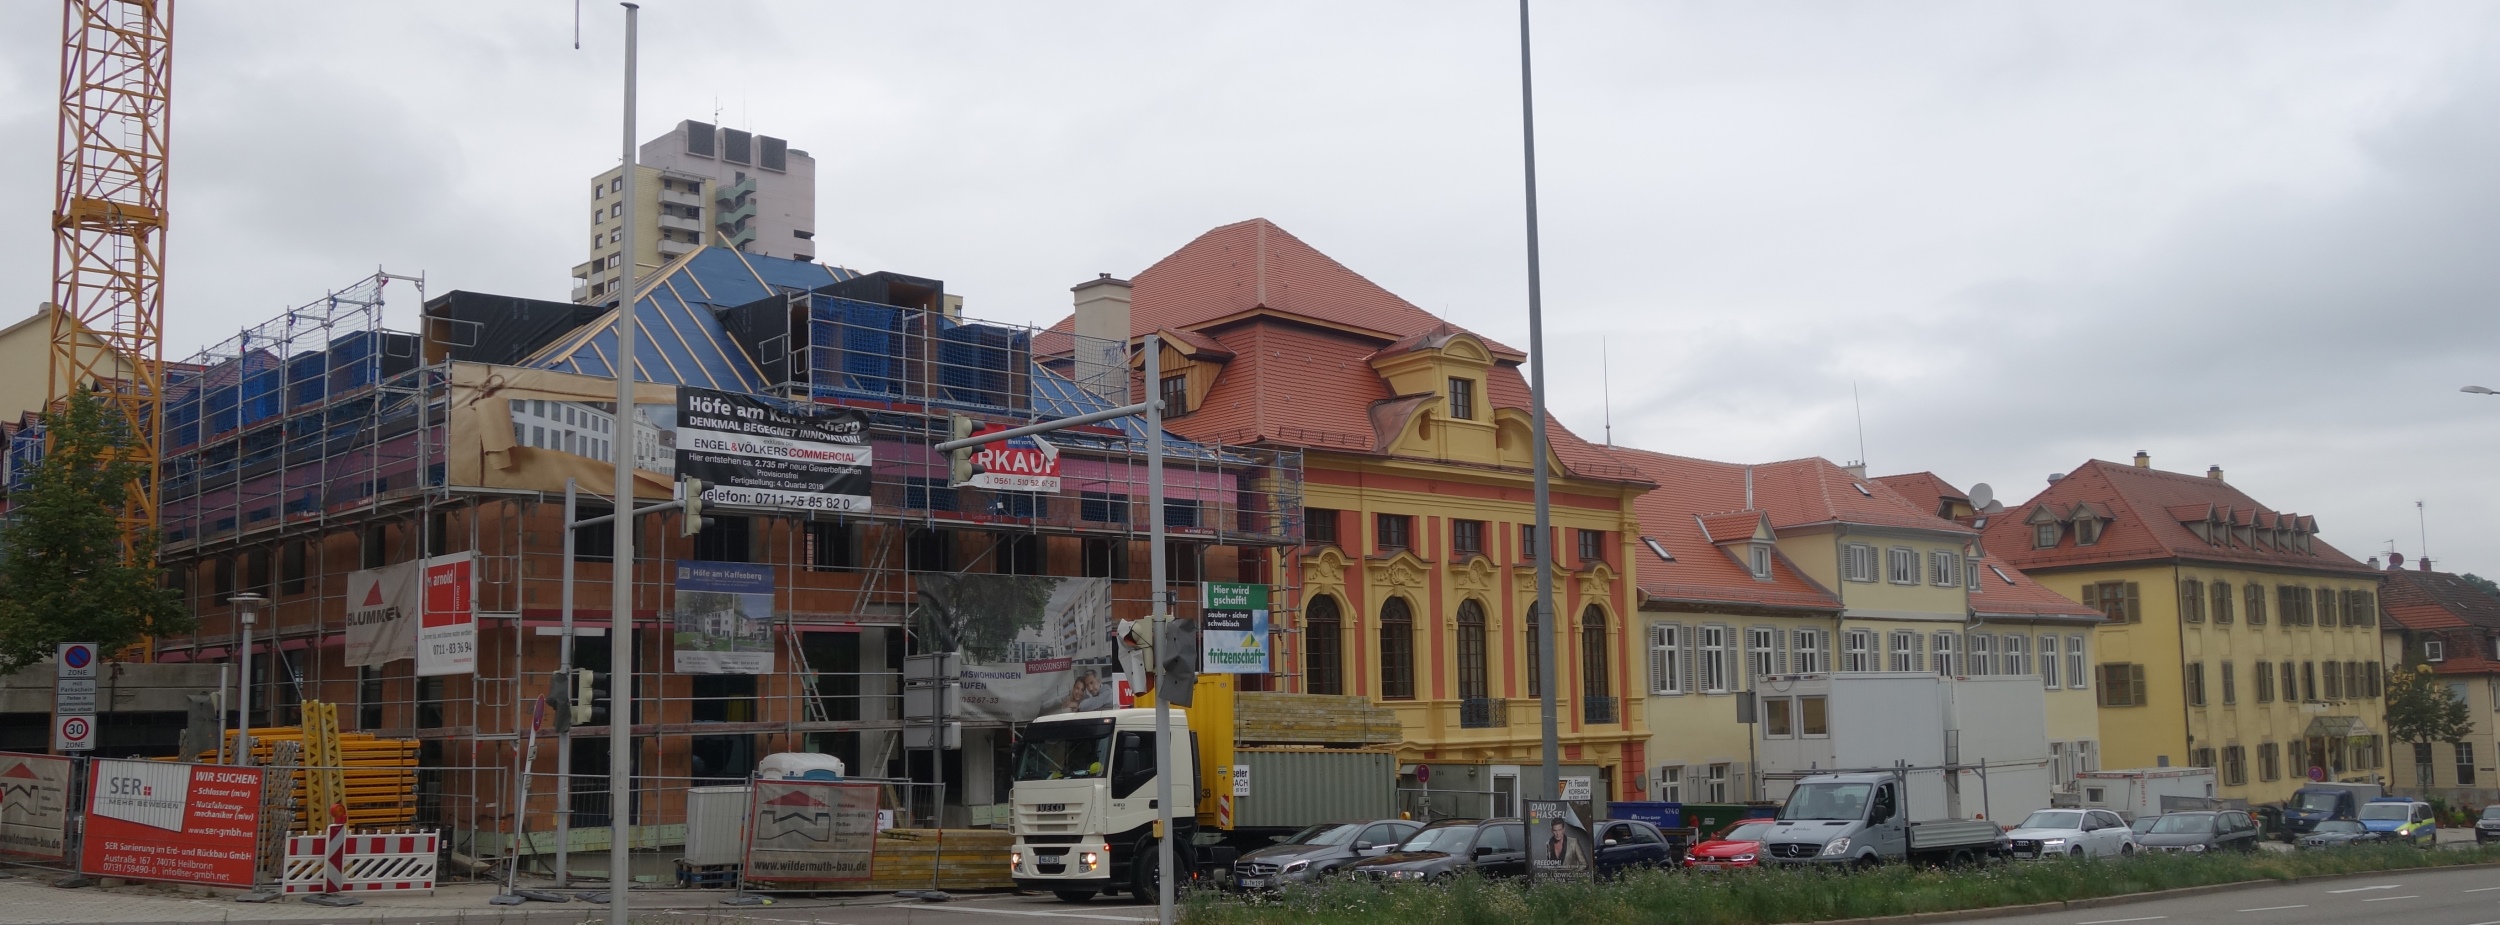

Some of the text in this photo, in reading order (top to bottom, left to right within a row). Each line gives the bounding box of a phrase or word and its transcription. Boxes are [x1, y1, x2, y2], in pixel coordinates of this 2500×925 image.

[689, 396, 731, 416] Höfe
[737, 406, 764, 421] am
[689, 416, 861, 445] DENKMAL BEGEGNET INNOVATION!
[789, 448, 857, 463] COMMERCIAL
[688, 453, 862, 476] Hier entstehen ca. 2.735 m² neue Gewerbeflächen
[757, 469, 799, 480] Provisionsfrei
[730, 475, 776, 488] Fertigstellung:
[784, 480, 807, 490] Quartal
[808, 482, 824, 490] 2019
[993, 477, 1012, 486] 0561
[1016, 478, 1029, 486] 510
[755, 492, 804, 507] 0711-75
[808, 495, 822, 508] 85
[826, 496, 840, 509] 82
[843, 498, 851, 510] 0
[433, 569, 454, 586] arnold
[693, 569, 710, 577] Höfe
[712, 570, 723, 578] am
[724, 571, 762, 581] Kaffeeberg
[1213, 585, 1250, 595] Hier wird
[1213, 595, 1247, 606] gschafft!
[433, 641, 472, 656] 0711 83 36 94
[1208, 648, 1265, 665] fritzenschaft
[68, 723, 84, 735] 30
[195, 771, 258, 785] WIR SUCHEN:
[110, 776, 142, 797] SER
[198, 787, 251, 799] Schlosser (m/w)
[137, 800, 179, 810] BEWEGEN
[195, 801, 244, 812] Nutzfahrzeug-
[1036, 804, 1065, 813] IVECO
[1531, 803, 1556, 811] DAVID
[194, 810, 254, 822] mechaniker (m/w)
[188, 827, 253, 838] www.ser-gmbh.net
[104, 842, 252, 861] SER Sanierung im Erd- und Rückbau GmbH
[104, 854, 214, 869] Austraße 167 74076 Heilbronn
[754, 860, 867, 872] www.wildermuth-bau.de
[162, 867, 230, 881] info@ser-gmbh.net
